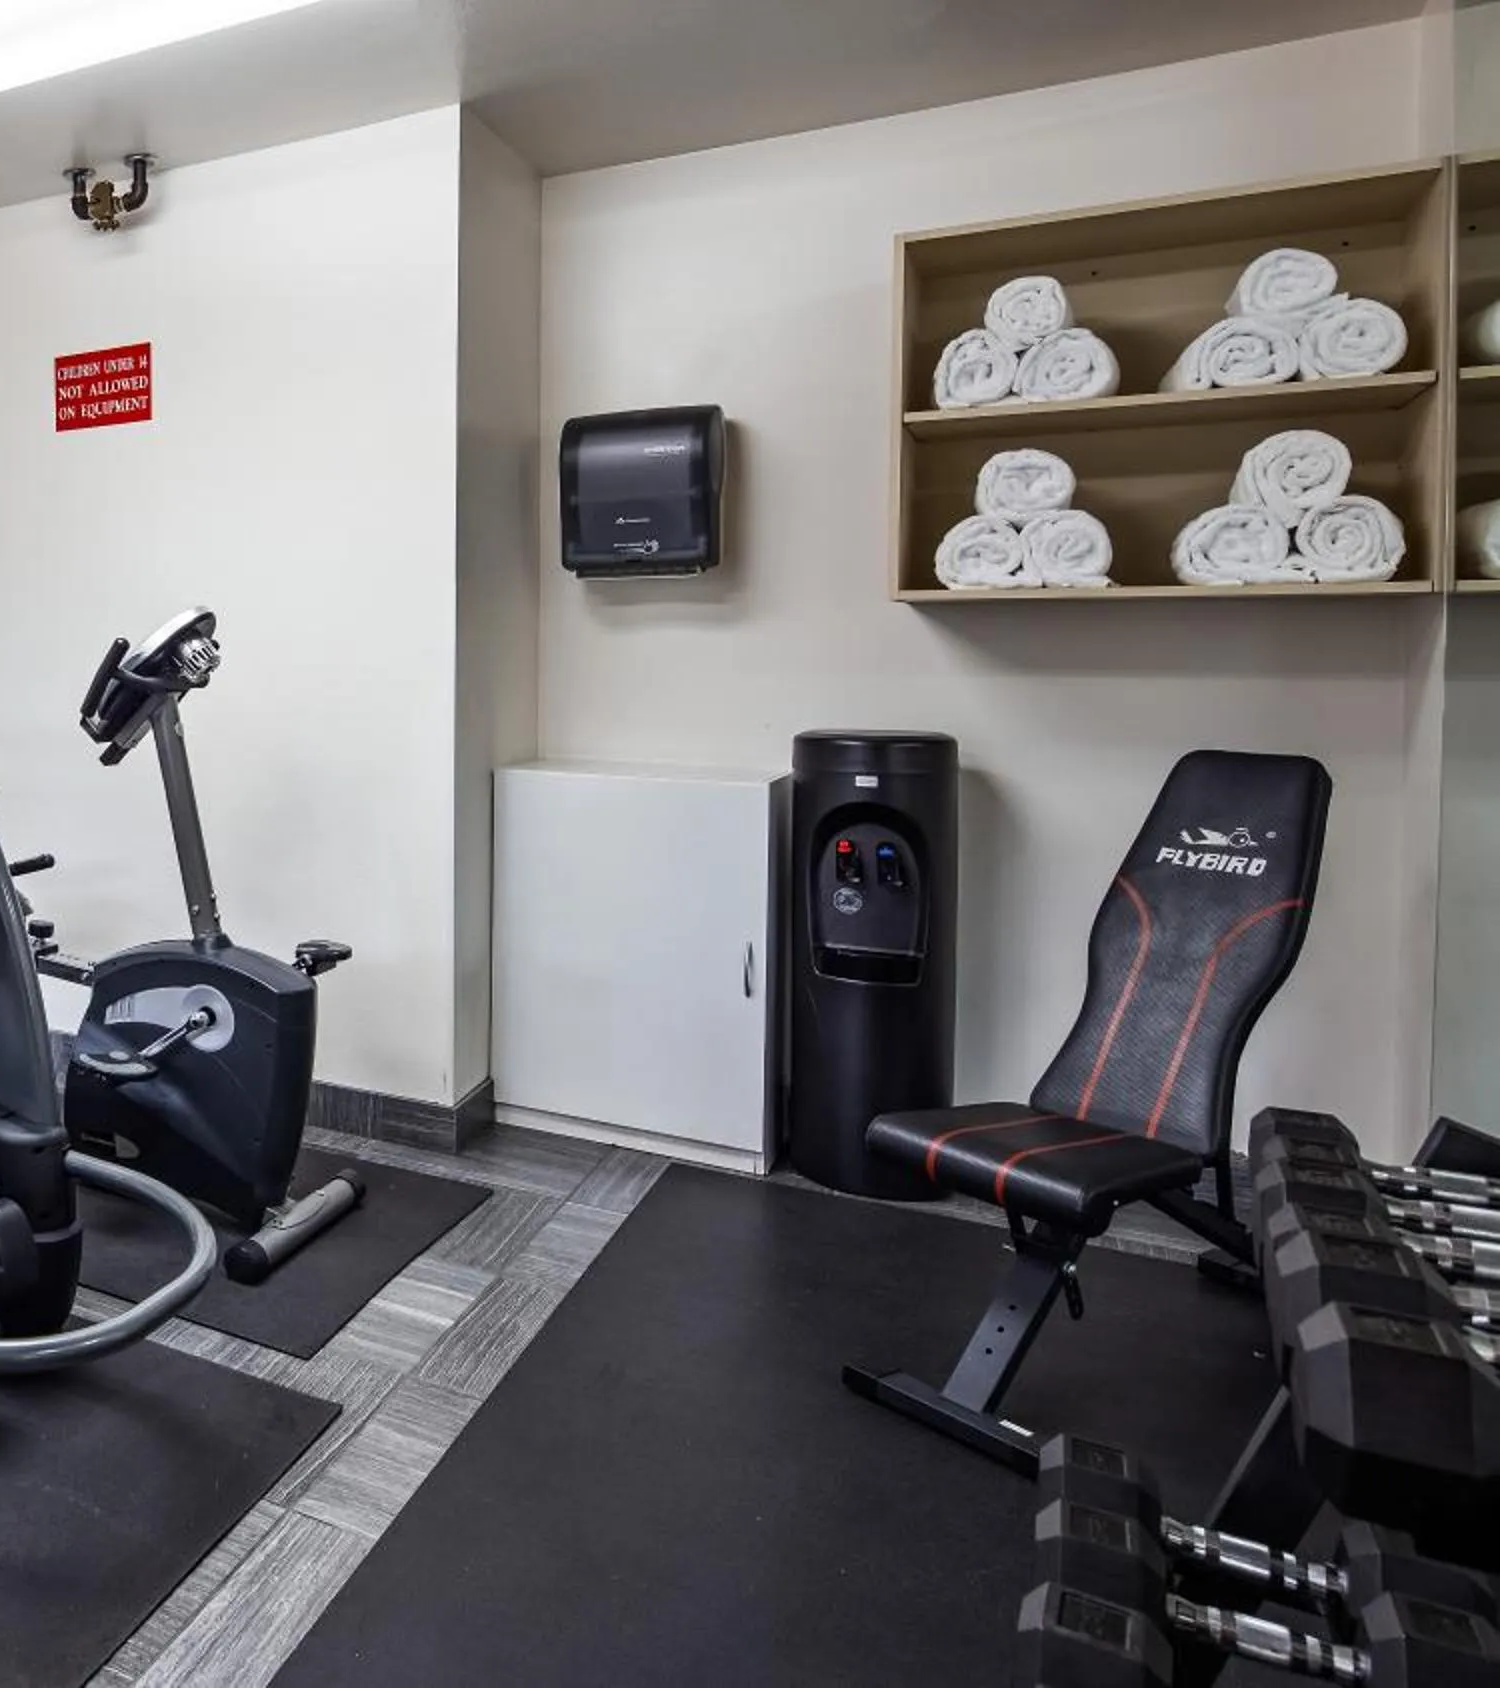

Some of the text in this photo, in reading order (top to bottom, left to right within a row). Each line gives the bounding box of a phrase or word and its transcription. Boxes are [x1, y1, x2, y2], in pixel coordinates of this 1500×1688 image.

[103, 357, 134, 373] UNDER
[58, 375, 148, 400] NOT ALLOWED
[58, 395, 148, 420] ON EQUIPMENT
[1155, 846, 1268, 877] FLYBIRD
